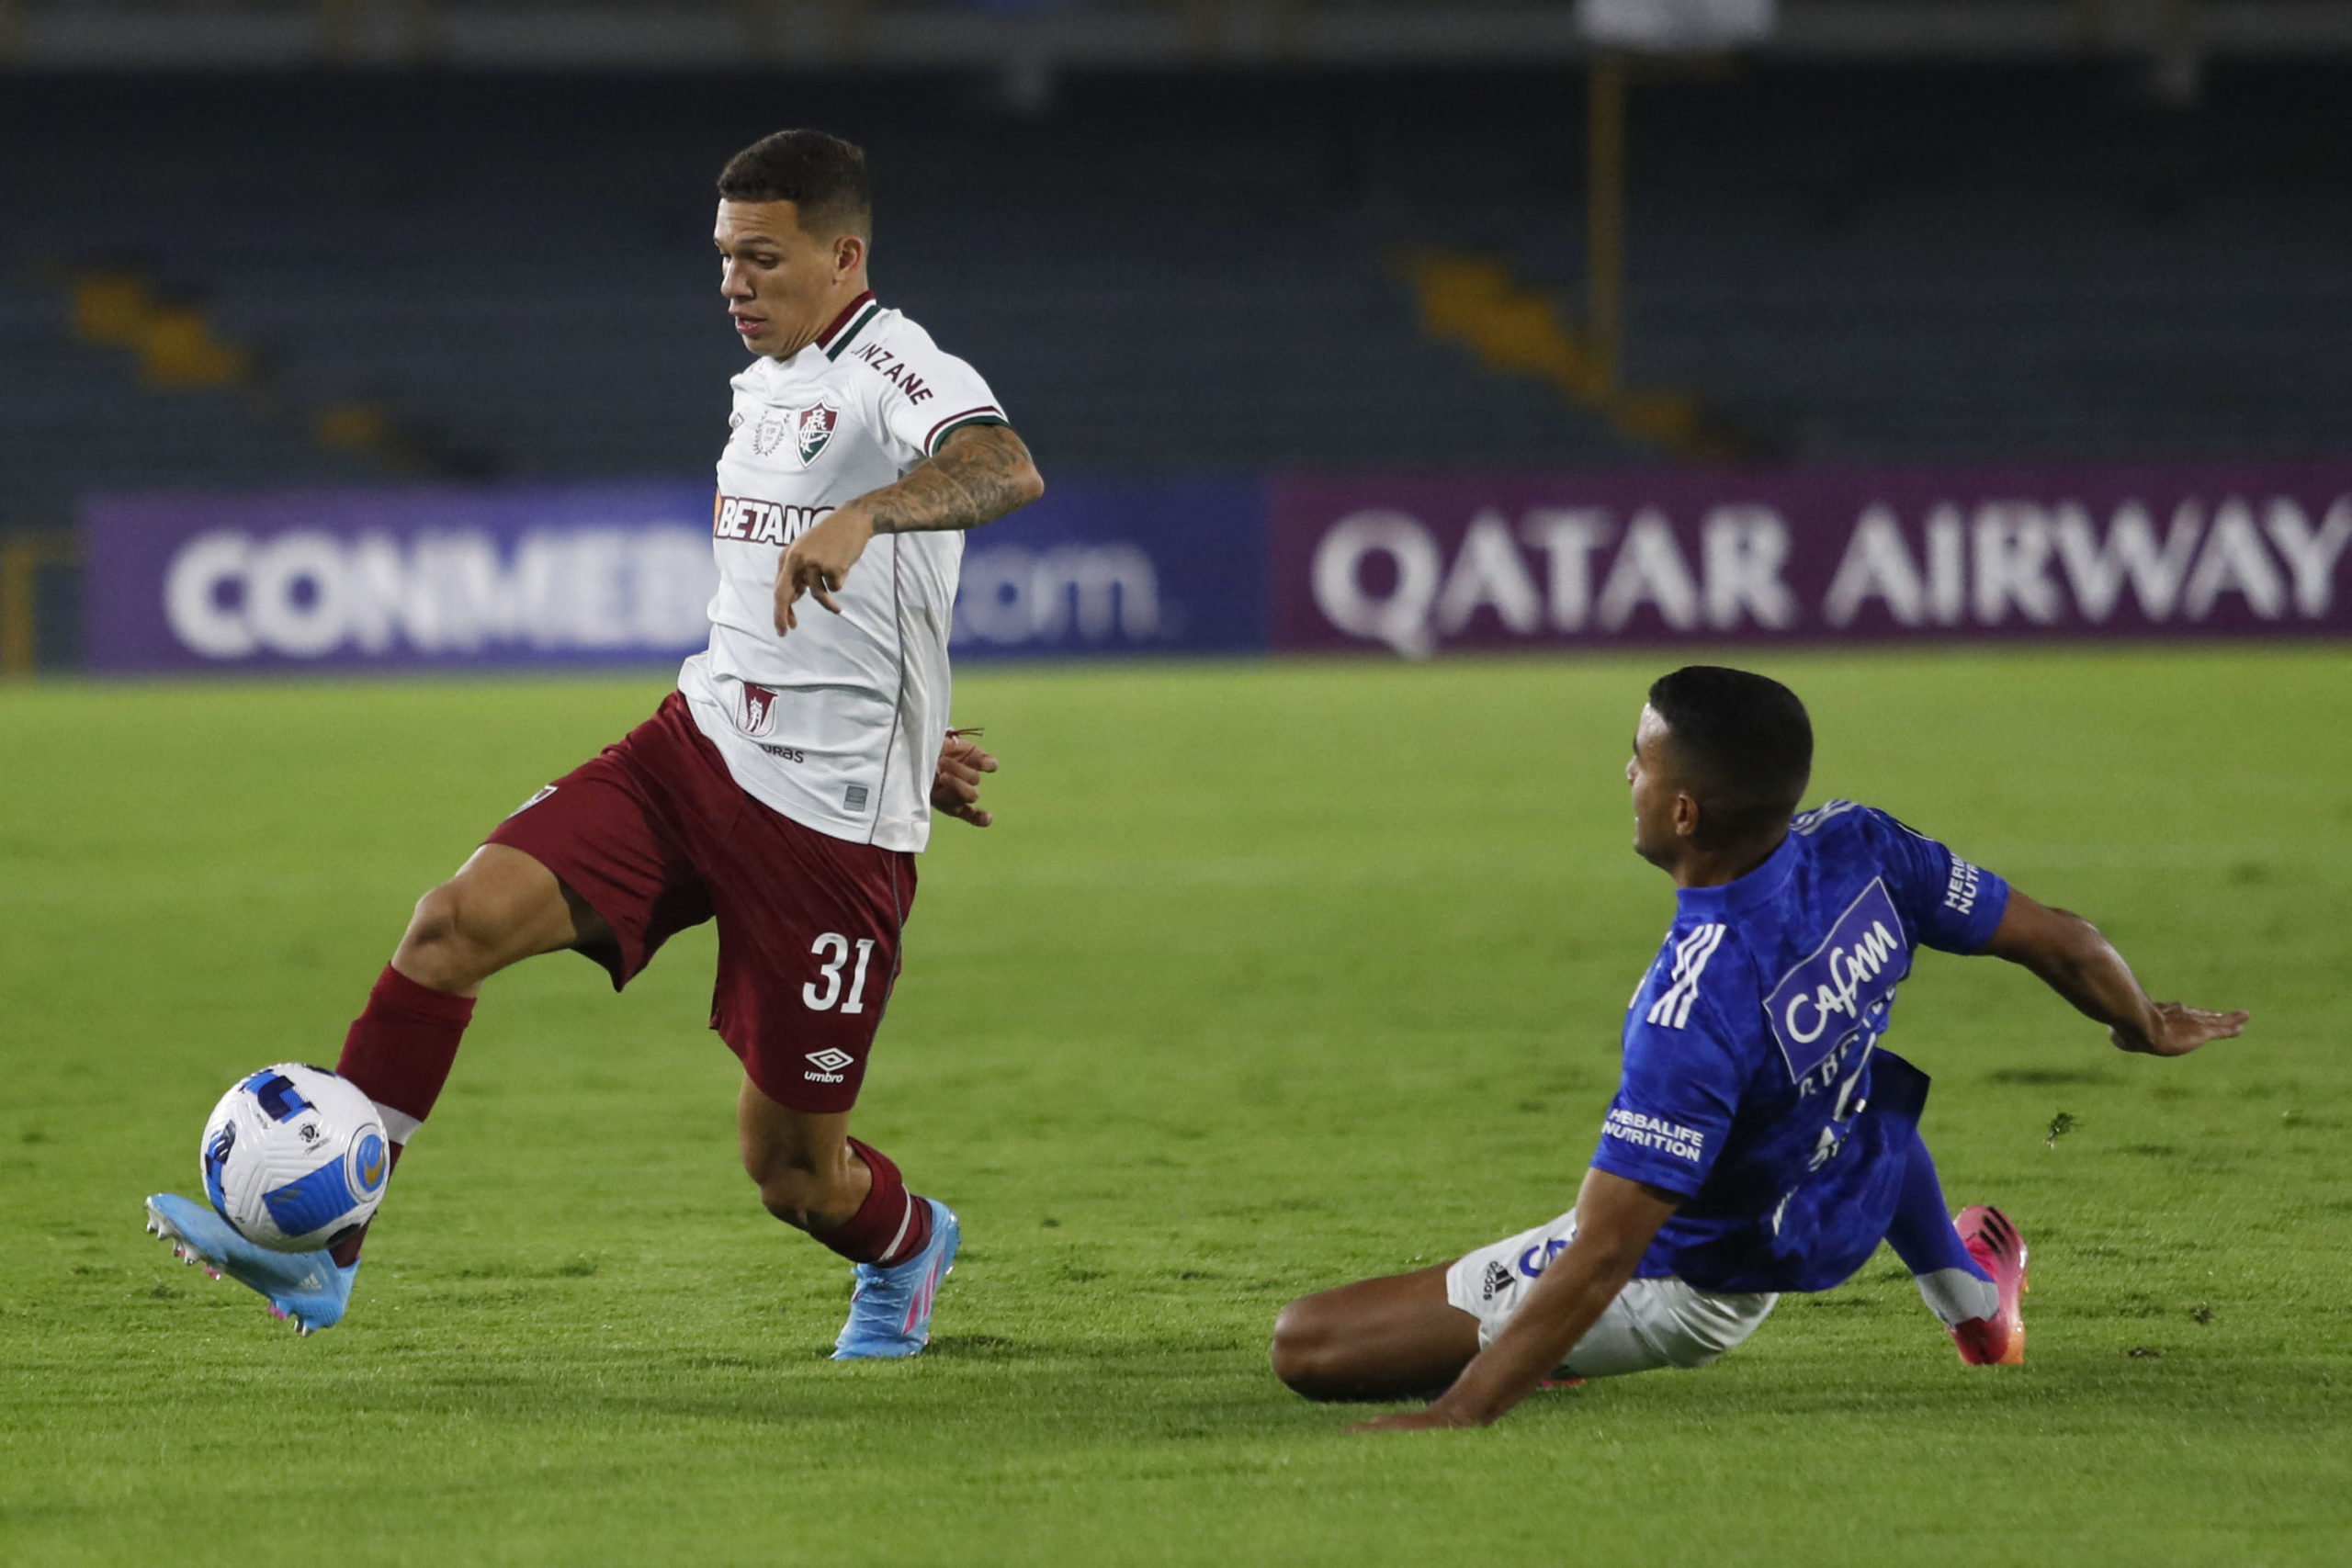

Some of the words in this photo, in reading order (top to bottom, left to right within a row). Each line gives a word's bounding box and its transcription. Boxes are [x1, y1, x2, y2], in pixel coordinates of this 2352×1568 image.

[851, 341, 933, 406] INZANE
[714, 496, 837, 546] BETAN
[953, 546, 1160, 645] om
[1311, 505, 1798, 661] QATAR
[1823, 496, 2352, 627] AIRWAY
[802, 932, 876, 1014] 31
[804, 1070, 844, 1084] umbro
[1601, 1121, 1702, 1163] NUTRITION
